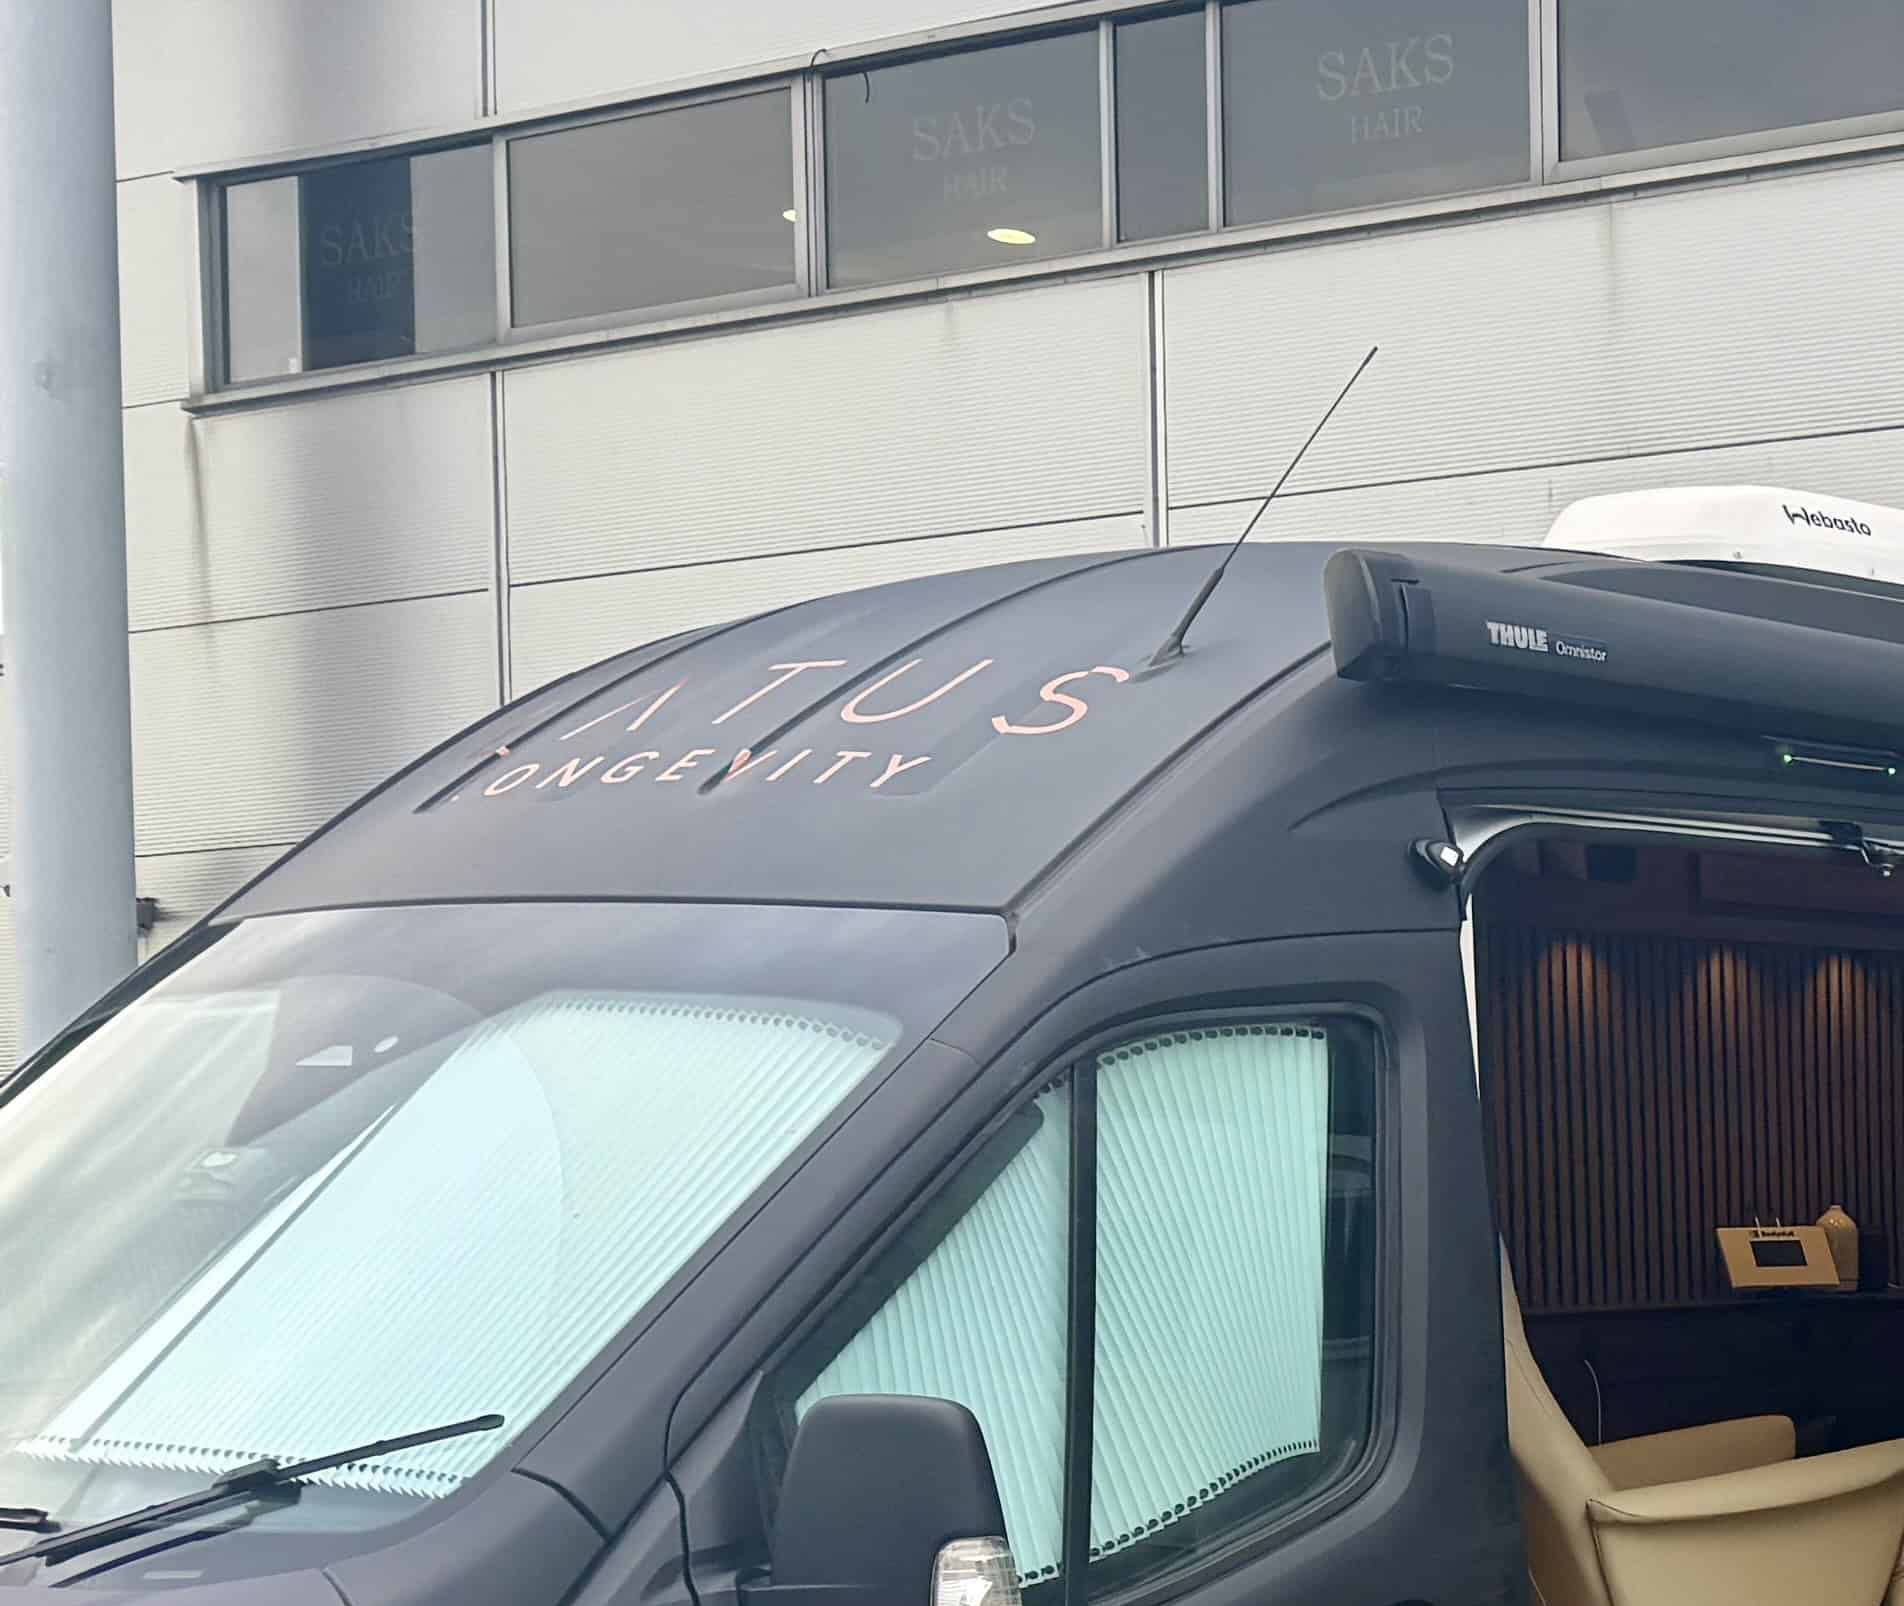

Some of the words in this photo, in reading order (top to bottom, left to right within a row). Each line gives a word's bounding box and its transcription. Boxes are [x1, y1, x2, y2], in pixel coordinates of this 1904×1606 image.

[1314, 33, 1454, 101] SAKS
[910, 97, 1036, 162] SAKS
[1351, 104, 1422, 144] HAIR
[944, 165, 1008, 201] HAIR
[319, 211, 420, 267] SAKS
[1781, 503, 1872, 537] Webasto
[1485, 620, 1549, 652] THULE
[450, 746, 932, 801] ONGEVITY
